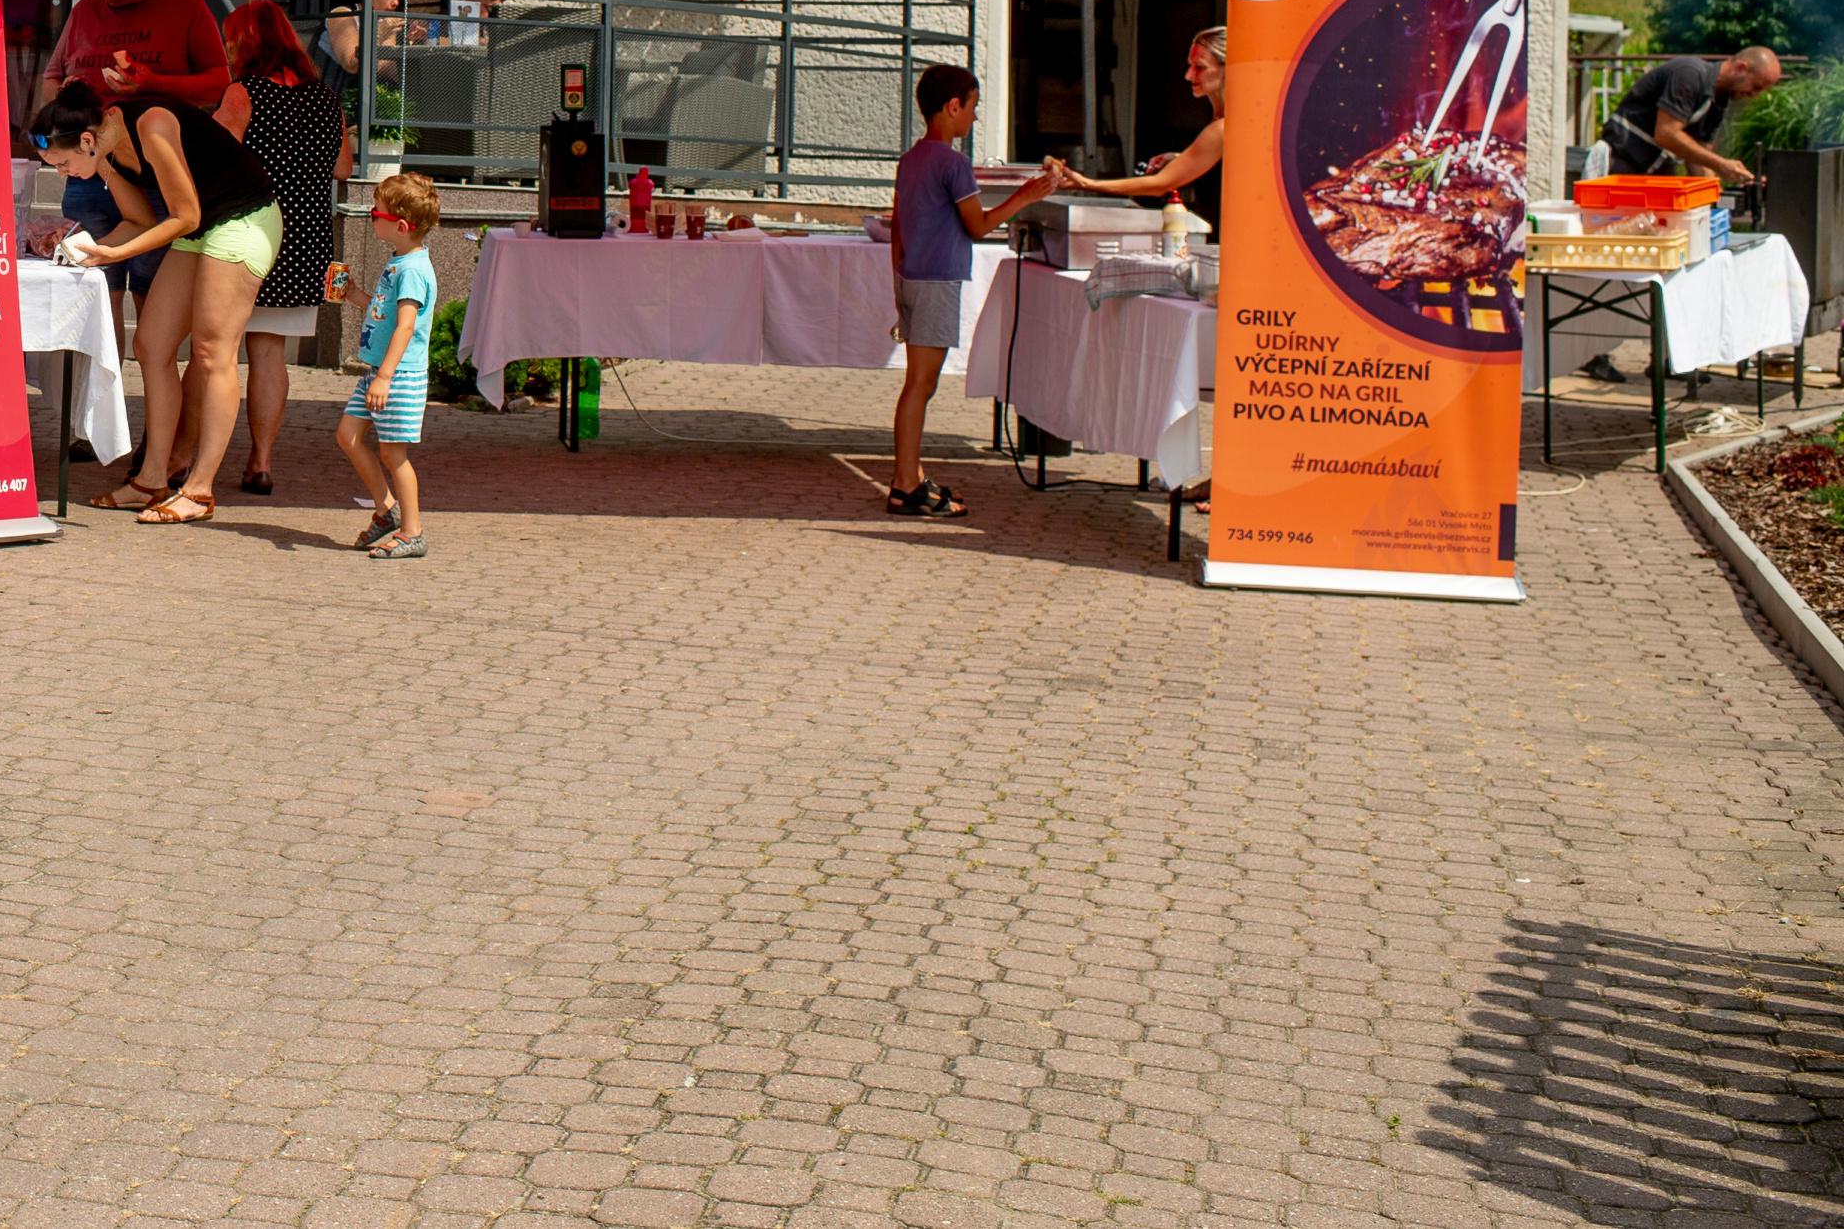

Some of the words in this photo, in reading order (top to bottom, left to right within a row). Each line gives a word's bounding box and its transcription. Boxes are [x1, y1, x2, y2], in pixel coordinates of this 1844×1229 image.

[97, 30, 153, 46] CUSTOM
[1236, 309, 1297, 327] GRILY
[1256, 331, 1340, 353] UDÍRNY
[1235, 353, 1327, 376] VÝČEPNÍ
[1332, 360, 1431, 382] ZAŘÍZENÍ
[1249, 380, 1313, 398] MASO
[1320, 383, 1351, 401] NA
[1356, 385, 1404, 403] GRIL
[1233, 403, 1286, 421] PIVO
[1289, 406, 1305, 422] A
[1309, 405, 1430, 429] LIMONÁDA
[1291, 453, 1443, 479] #masonásbaví
[9, 478, 28, 492] 407
[1227, 528, 1254, 541] 734
[1257, 529, 1284, 543] 599
[1287, 530, 1314, 545] 946
